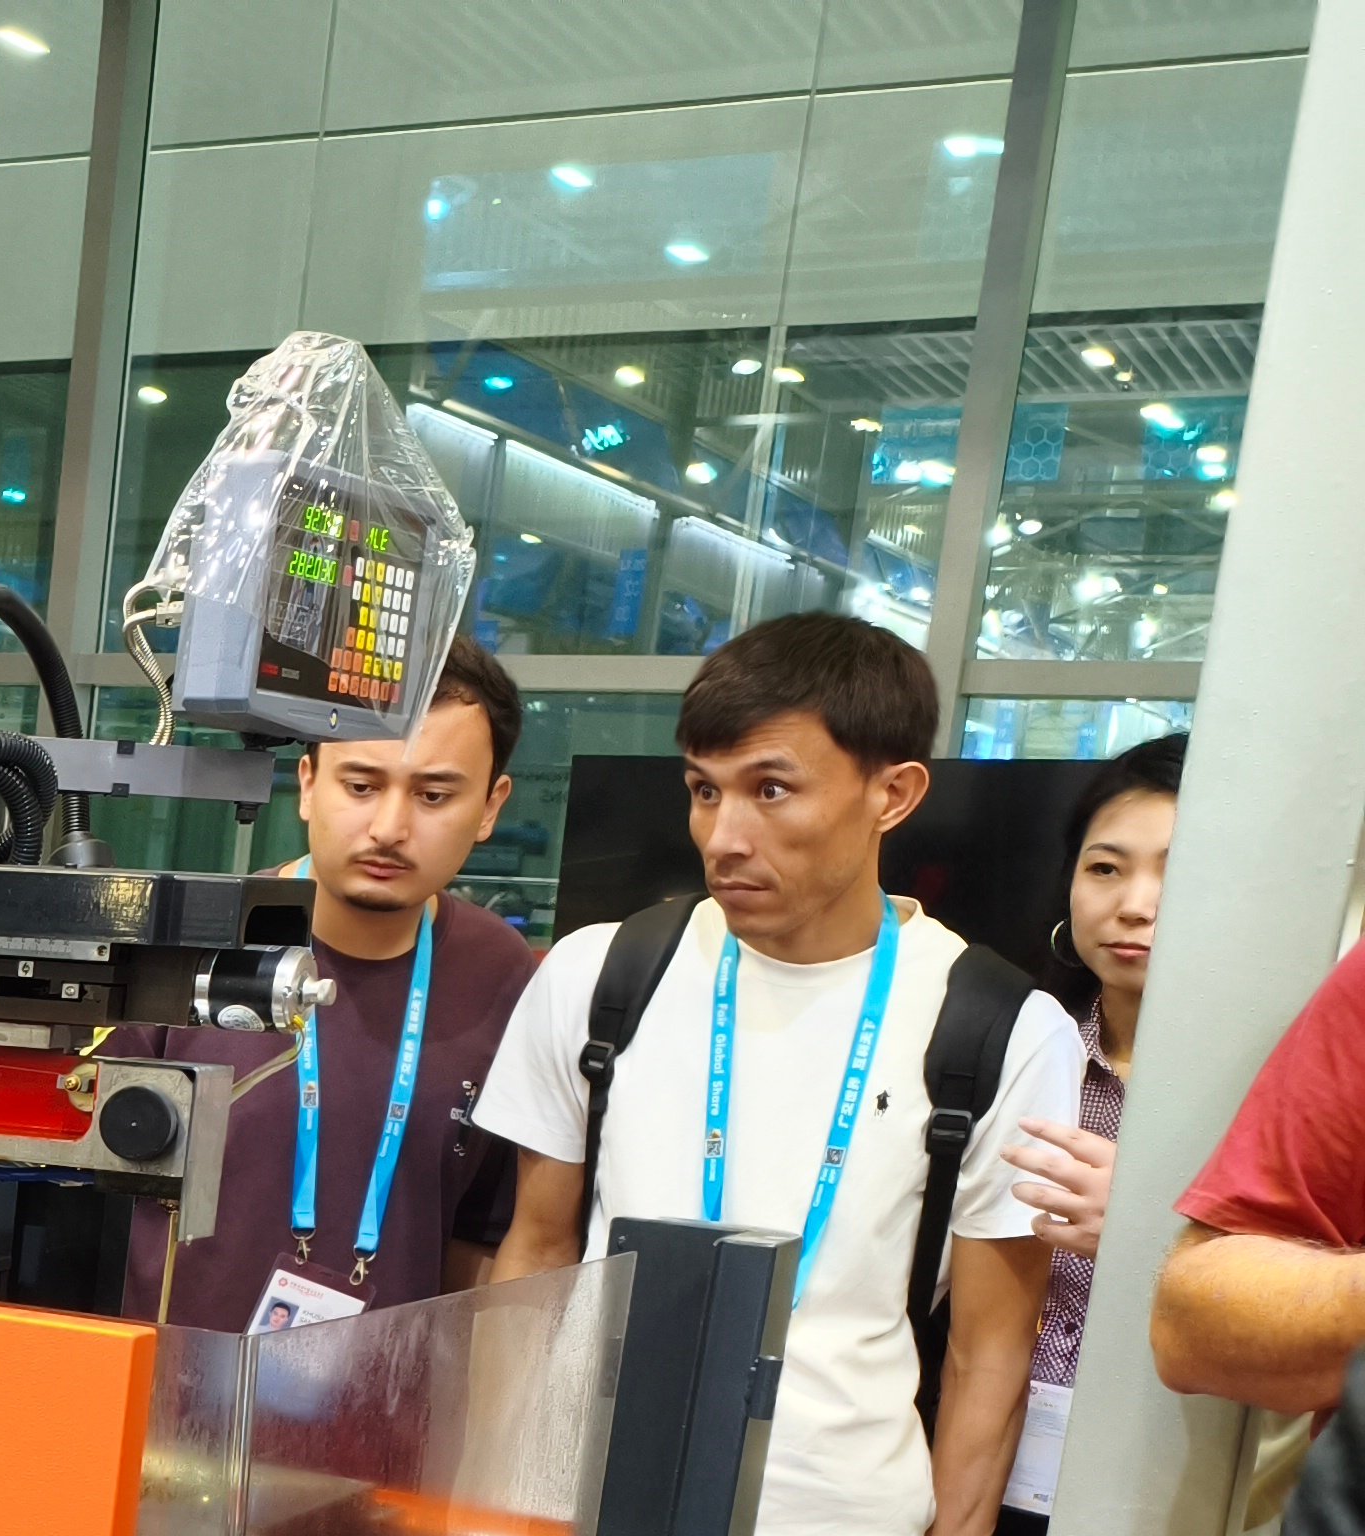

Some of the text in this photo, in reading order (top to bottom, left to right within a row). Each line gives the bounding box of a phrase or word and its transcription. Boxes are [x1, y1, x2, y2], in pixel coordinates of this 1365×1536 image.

[710, 955, 732, 1116] Canton Fair Global Share
